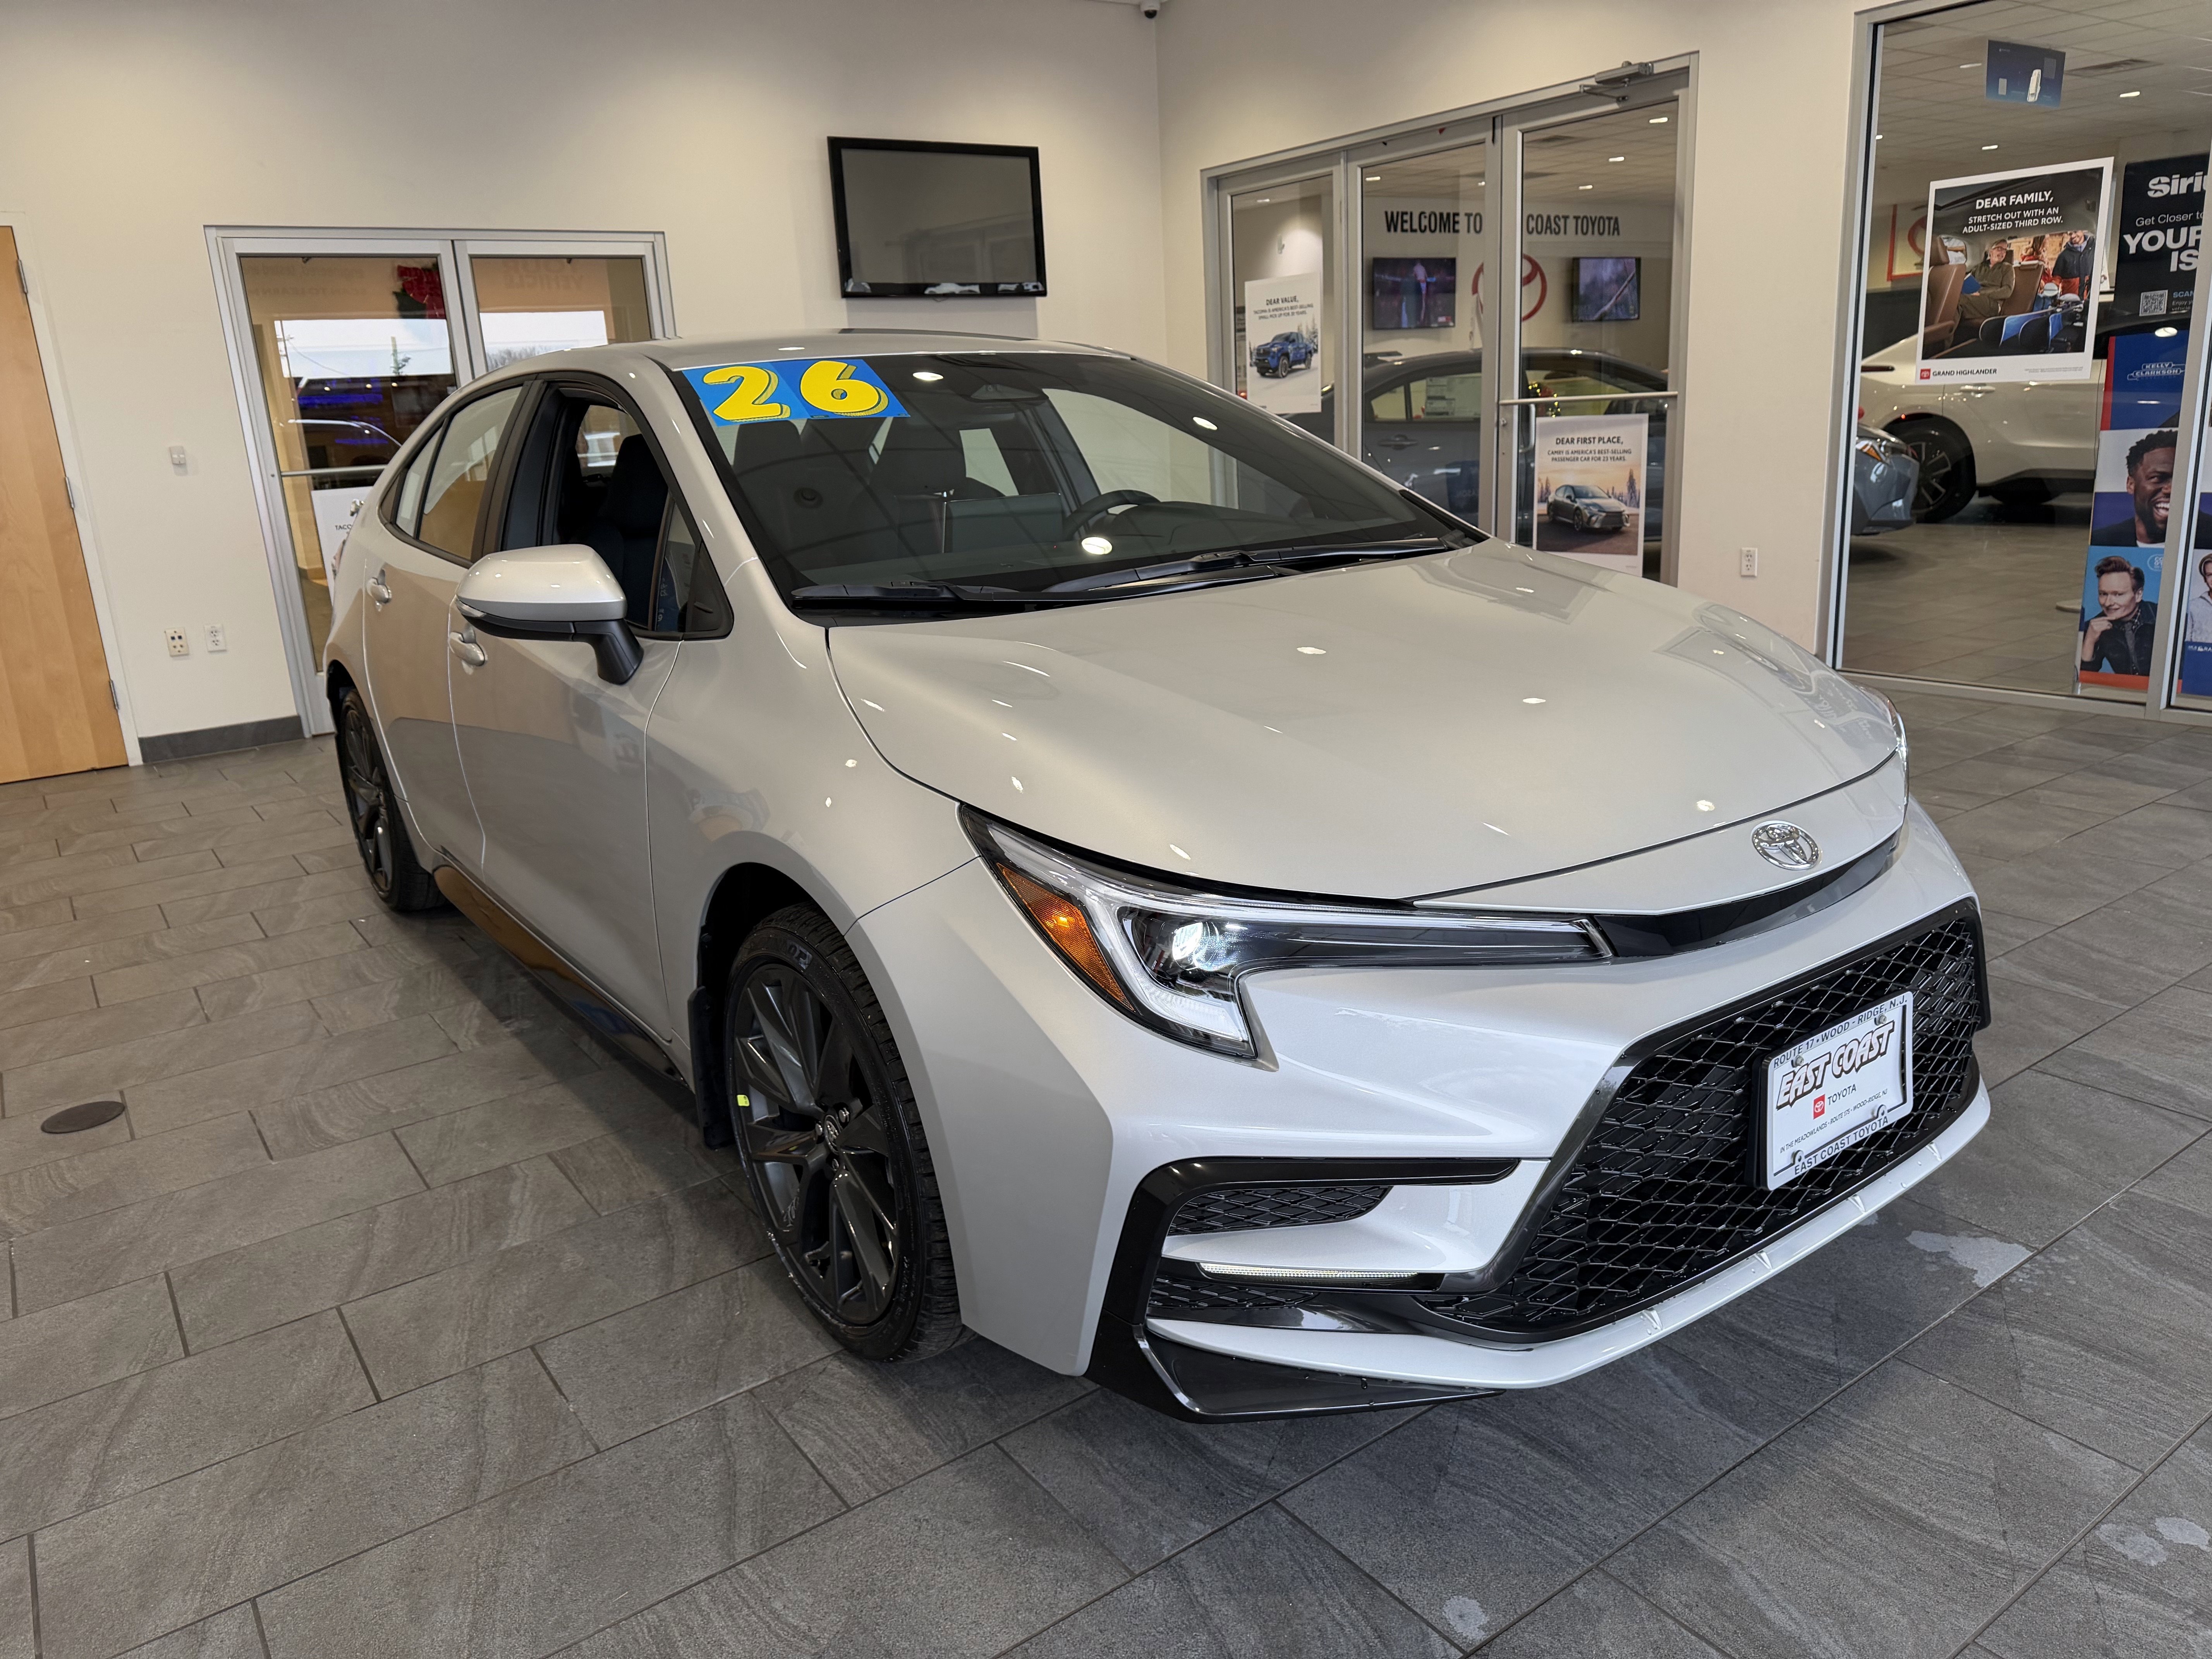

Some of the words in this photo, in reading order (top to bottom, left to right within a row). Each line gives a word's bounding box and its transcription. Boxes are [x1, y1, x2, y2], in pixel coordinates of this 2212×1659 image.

[1976, 196, 2007, 210] DEAR
[2009, 190, 2054, 205] FAMILY,
[1385, 211, 1459, 233] WELCOME
[1465, 213, 1482, 233] TO
[1527, 214, 1568, 235] COAST
[1573, 215, 1620, 236] TOYOTA
[1962, 222, 2013, 234] ADULT-SIZED
[2014, 218, 2039, 228] THIRD
[2041, 216, 2063, 225] ROW.
[1968, 213, 2002, 224] STRETCH
[2004, 211, 2021, 220] OUT
[2023, 208, 2044, 218] WITH
[2046, 206, 2059, 215] AN
[2136, 216, 2155, 227] Get
[2158, 213, 2193, 224] Closer
[2170, 249, 2199, 272] IS
[703, 361, 889, 422] 26
[1598, 436, 1623, 444] PLACE,
[1774, 1046, 1802, 1068] ROUTE
[1807, 1039, 1814, 1050] 17
[1821, 1022, 1850, 1042] WOOD
[1858, 1005, 1887, 1024] RIDGE,
[1890, 995, 1907, 1009] N.J.
[1776, 1052, 1831, 1110] EAST
[1832, 1020, 1894, 1078] COAST
[1828, 1084, 1856, 1105] TOYOTA
[1786, 1141, 1794, 1150] THE
[1795, 1121, 1827, 1146] MEADOWLANDS
[1830, 1113, 1843, 1125] ROUTE
[1853, 1093, 1881, 1111] WOOD-RIDGE,
[1882, 1088, 1888, 1096] NJ
[1795, 1154, 1818, 1175] EAST
[1820, 1135, 1851, 1160] COAST
[1854, 1116, 1888, 1141] TOYOTA
